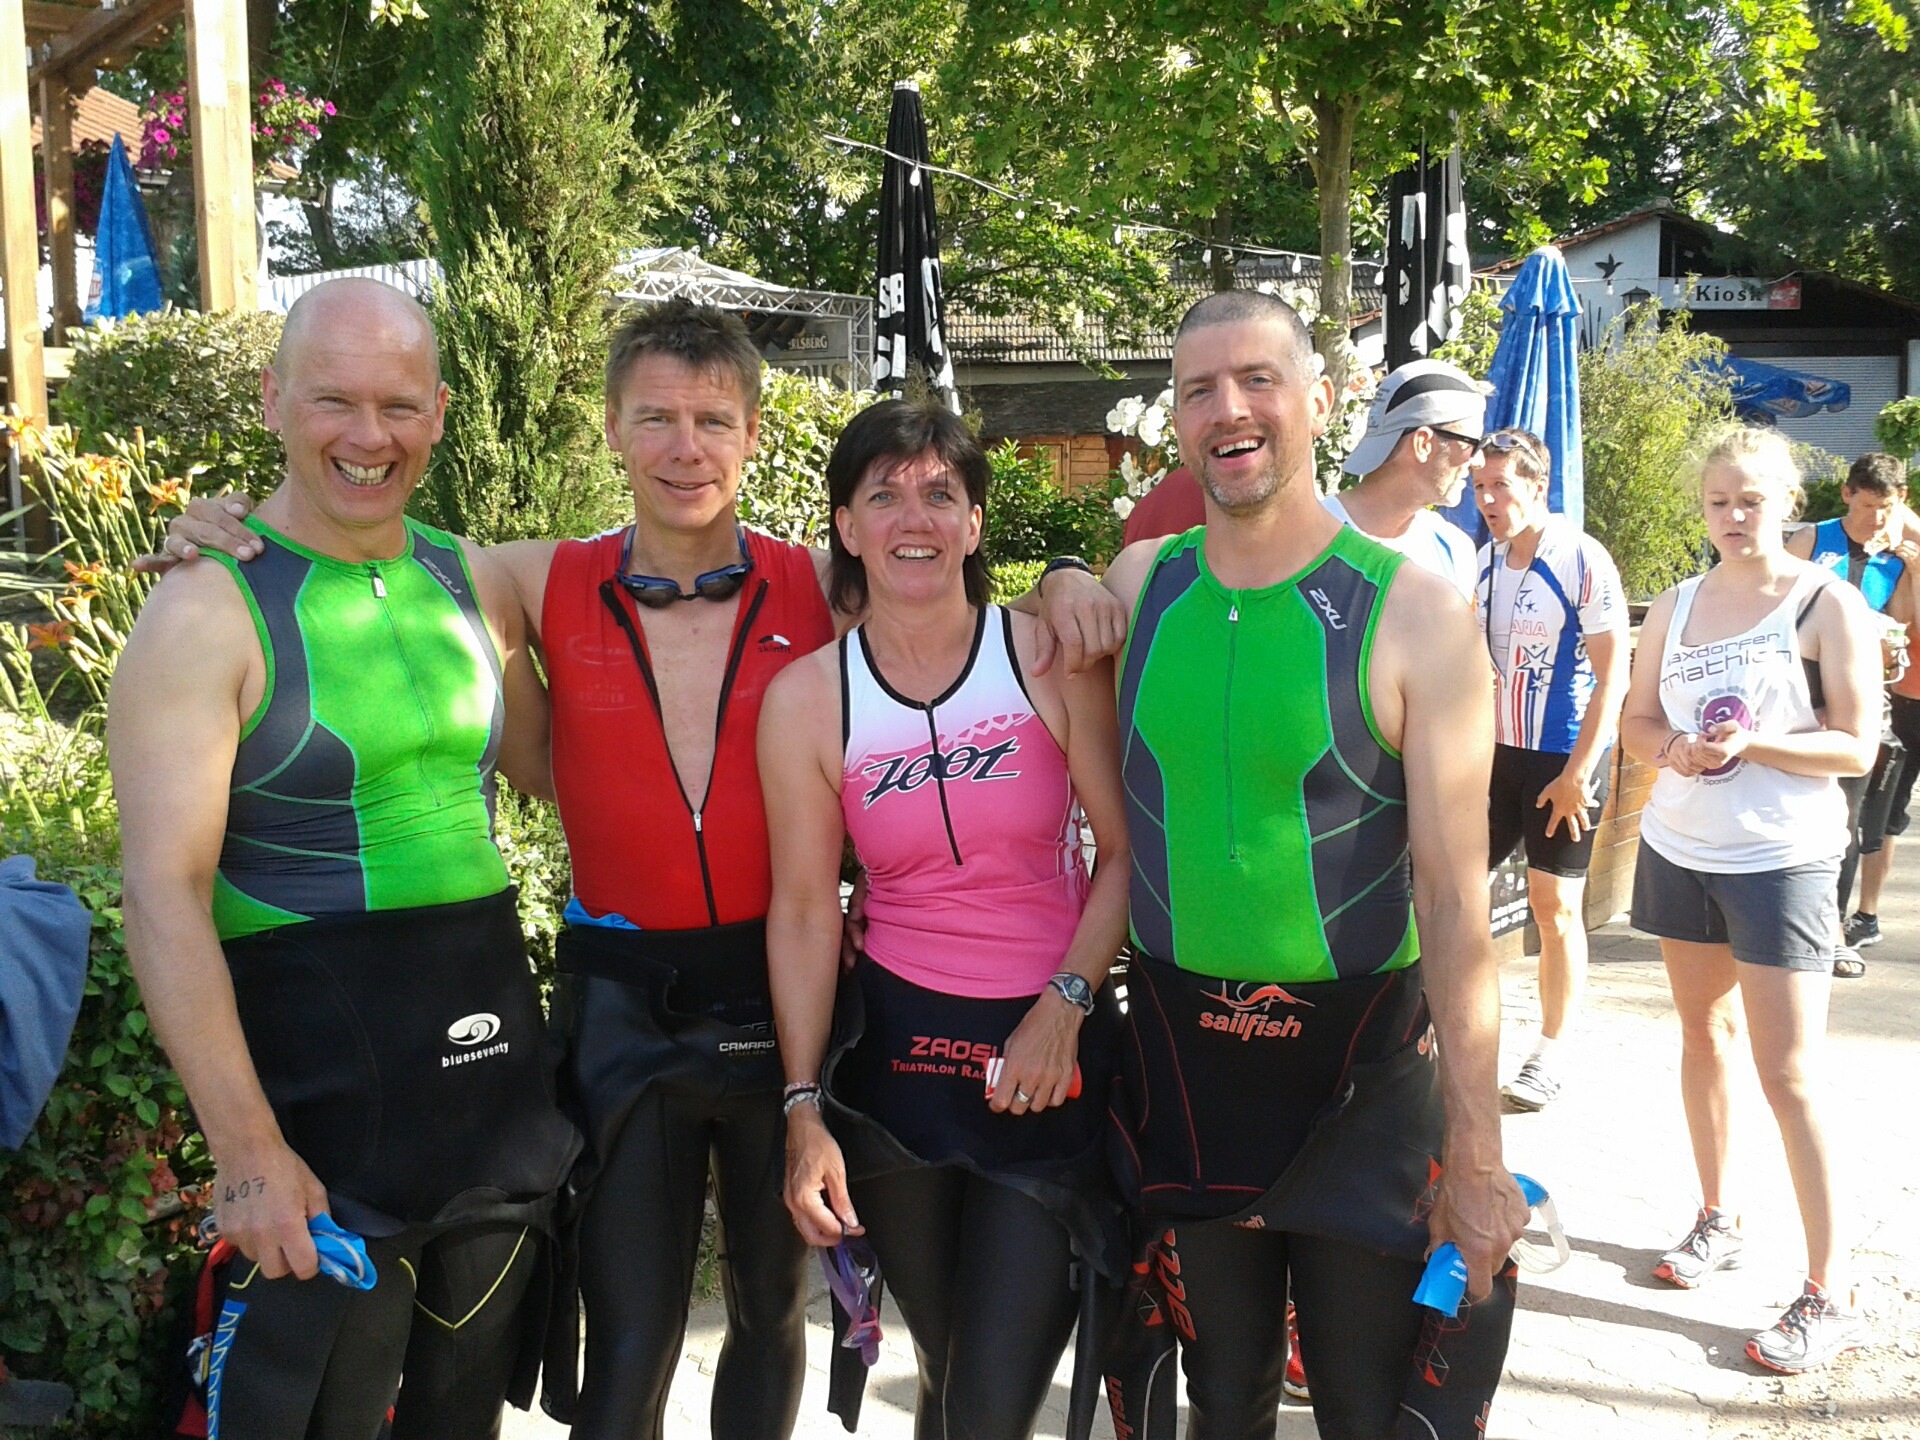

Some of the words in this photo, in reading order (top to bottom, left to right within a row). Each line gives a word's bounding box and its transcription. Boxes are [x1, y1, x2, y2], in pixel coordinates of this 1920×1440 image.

[1309, 588, 1347, 629] 2XU
[1199, 1012, 1302, 1041] sailfish
[442, 1042, 509, 1068] blueseventy
[719, 1040, 775, 1052] CAMARO
[225, 1177, 265, 1202] 407
